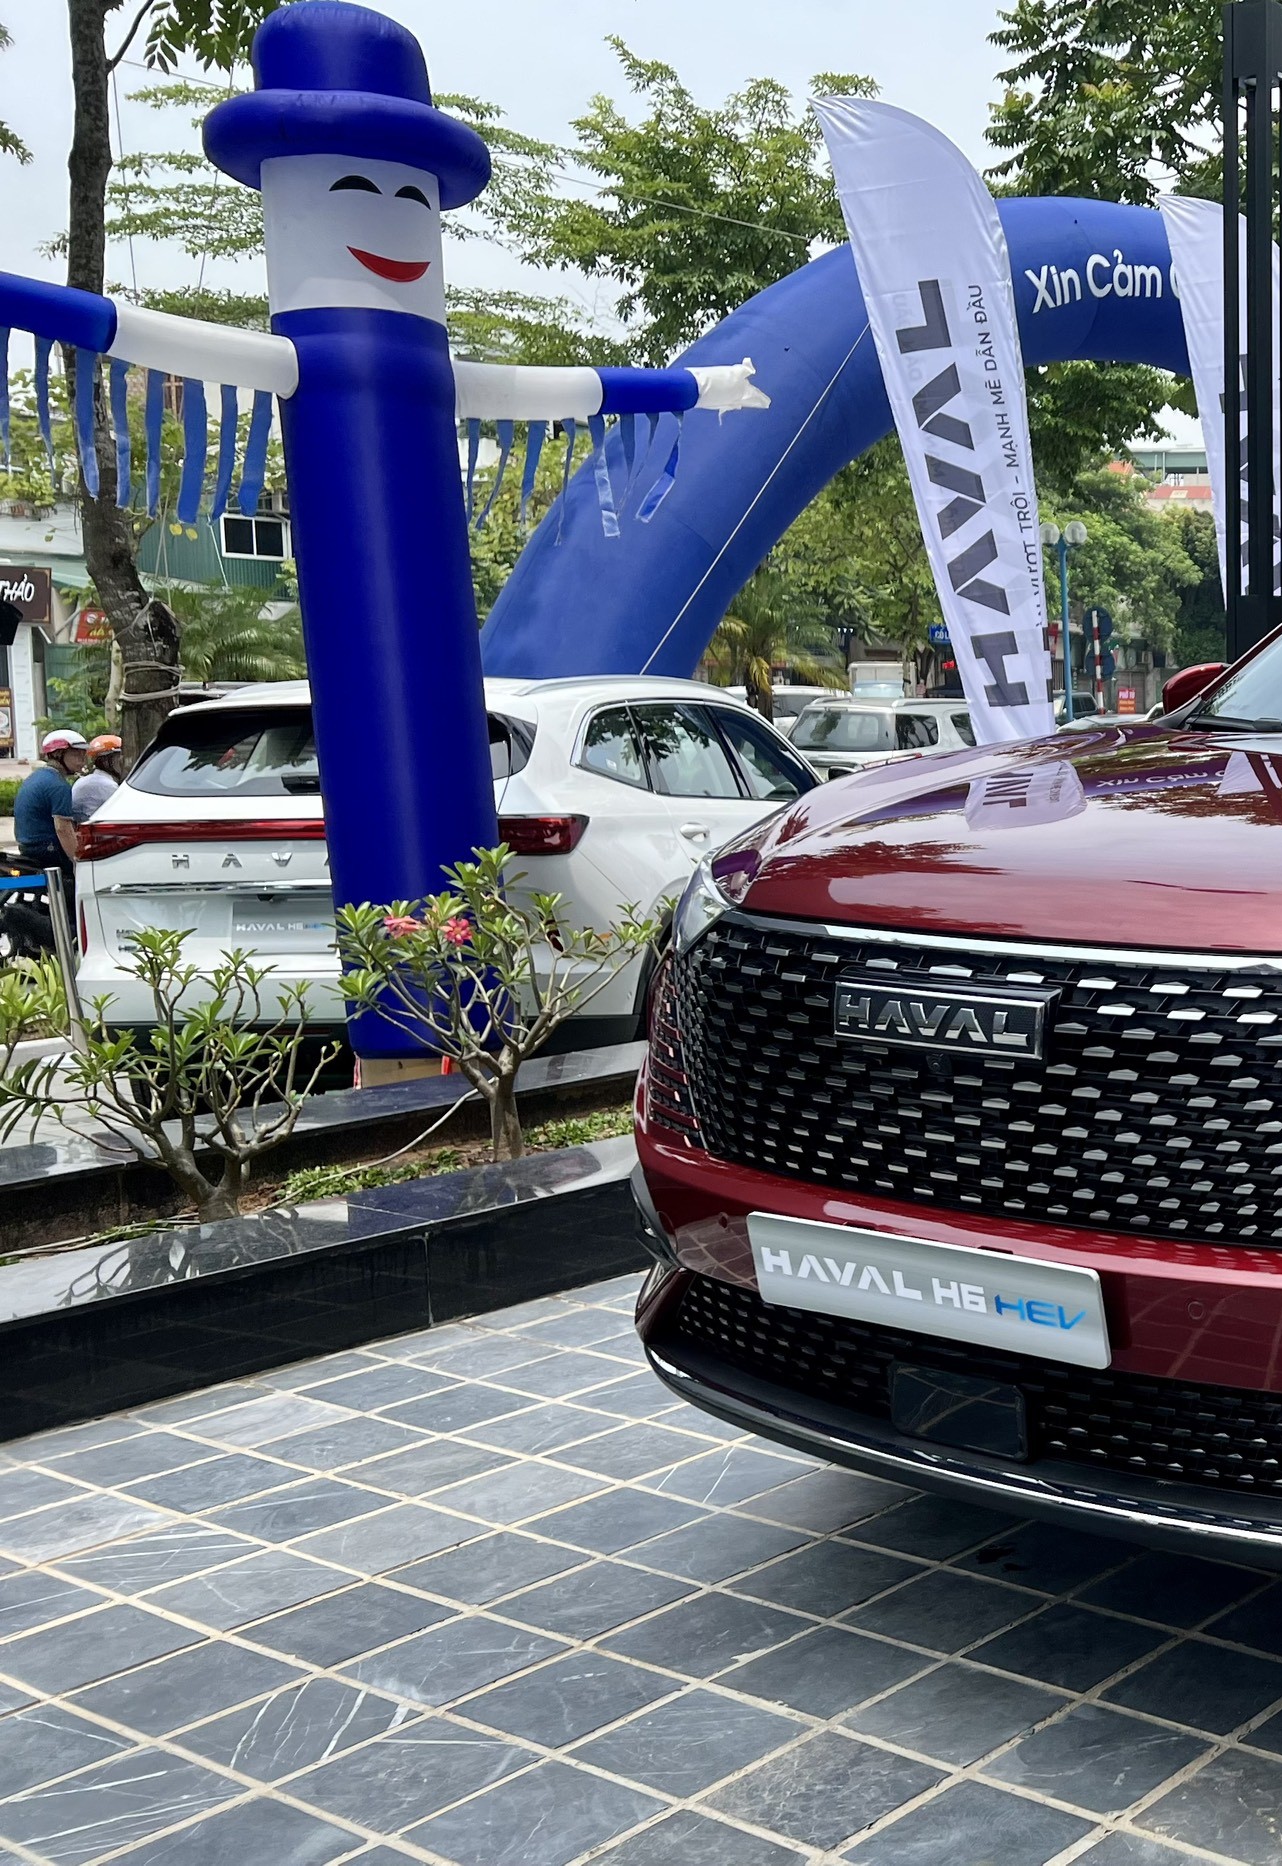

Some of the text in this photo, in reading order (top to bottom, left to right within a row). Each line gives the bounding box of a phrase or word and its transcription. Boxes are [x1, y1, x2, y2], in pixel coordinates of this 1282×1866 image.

[1024, 248, 1163, 315] Xin Cảm
[967, 284, 989, 324] ĐẦU
[975, 332, 998, 371] DẪN
[984, 379, 1005, 404] MẼ
[995, 412, 1018, 469] MẠNH
[895, 279, 1030, 707] HAVAL
[1010, 492, 1033, 533] TRỘI
[172, 853, 329, 869] HAV
[236, 923, 285, 931] HAVAL
[839, 994, 1028, 1046] HAVAL
[761, 1247, 1086, 1330] HAVAL H6 HEV
